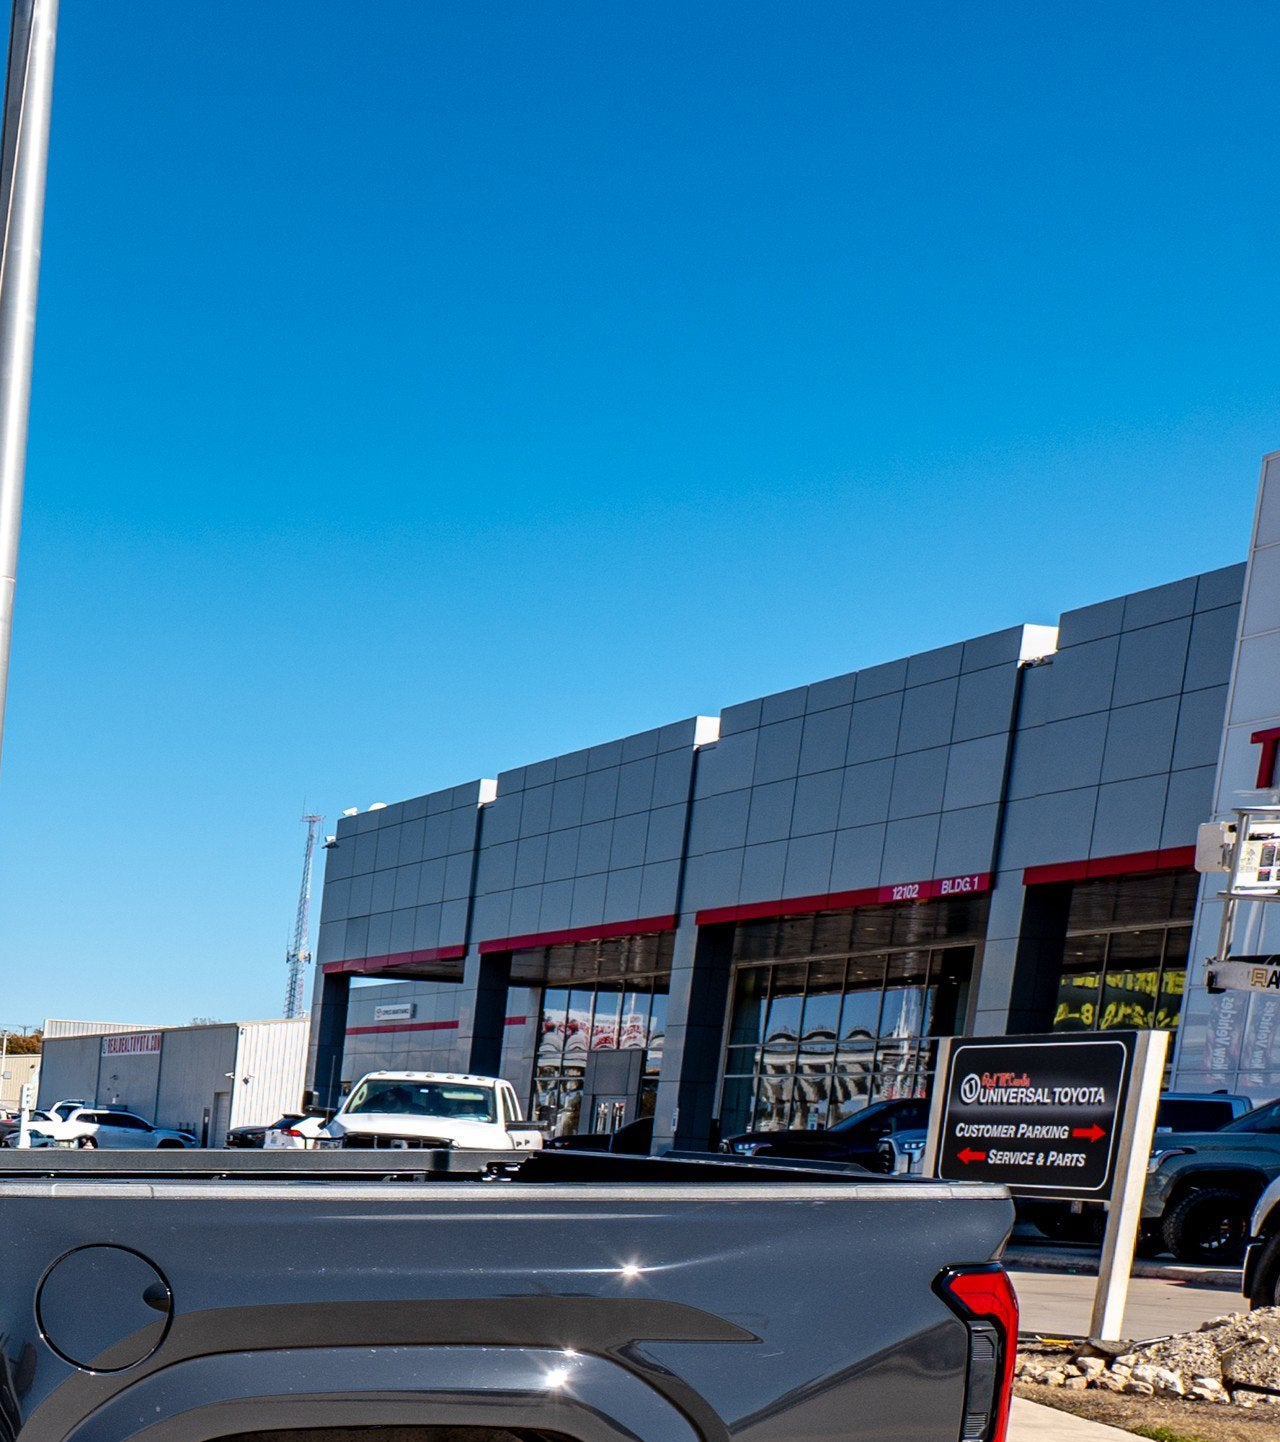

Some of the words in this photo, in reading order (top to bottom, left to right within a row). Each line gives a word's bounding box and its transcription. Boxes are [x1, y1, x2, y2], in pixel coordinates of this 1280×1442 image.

[892, 884, 920, 900] 12102
[979, 1087, 1051, 1103] UNIVERSAL
[1053, 1087, 1106, 1103] TOYOTA
[955, 1122, 1015, 1138] CUSTOMER
[1017, 1123, 1070, 1139] PARKING
[987, 1149, 1035, 1165] SERVICE
[1036, 1153, 1044, 1166] &
[1046, 1151, 1086, 1167] PARTS
